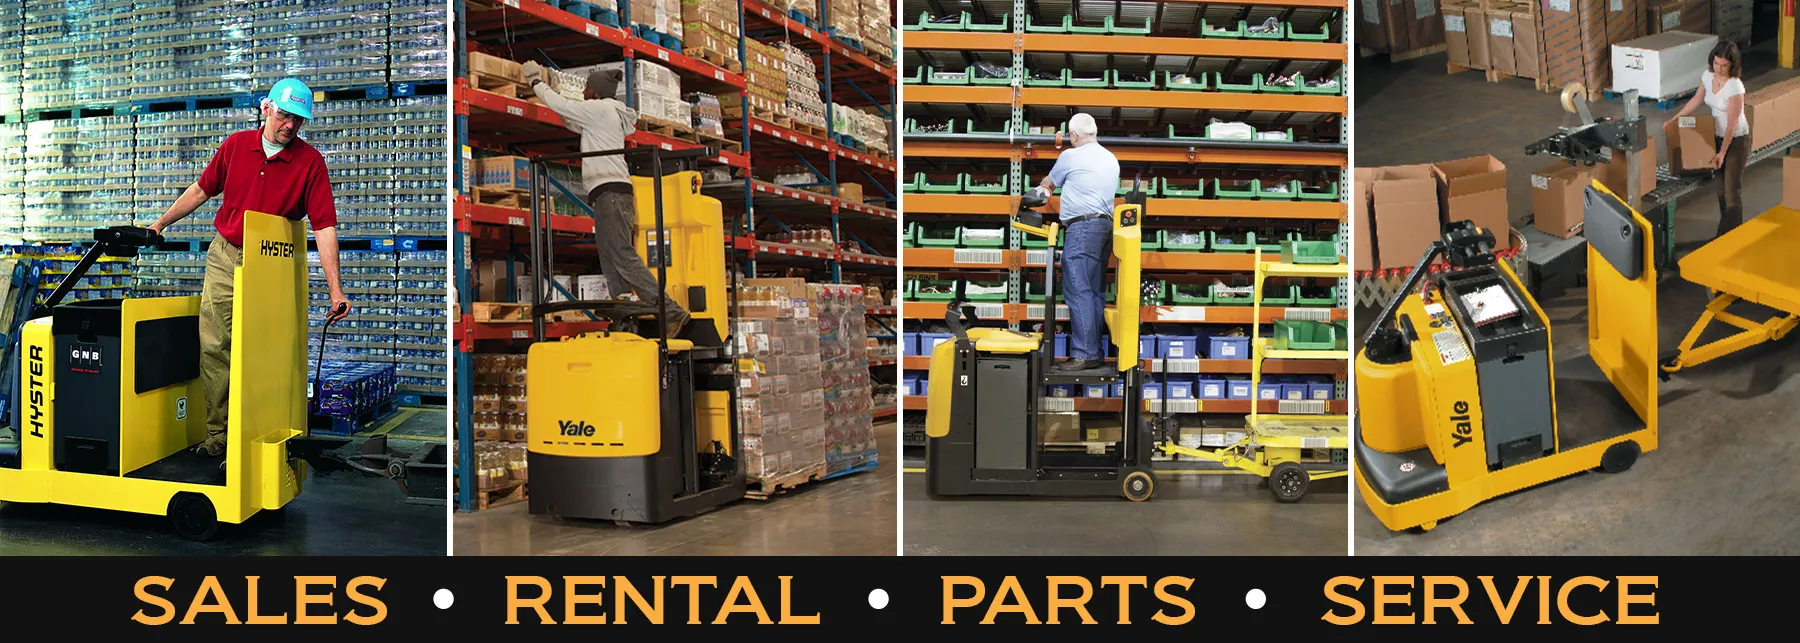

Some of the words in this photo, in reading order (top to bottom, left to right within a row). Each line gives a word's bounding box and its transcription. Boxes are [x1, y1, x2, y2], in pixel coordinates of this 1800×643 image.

[260, 239, 295, 258] HYSTER
[71, 349, 99, 361] GNB
[30, 344, 44, 439] HYSTER
[557, 420, 596, 437] Yale
[1450, 400, 1473, 449] Yale
